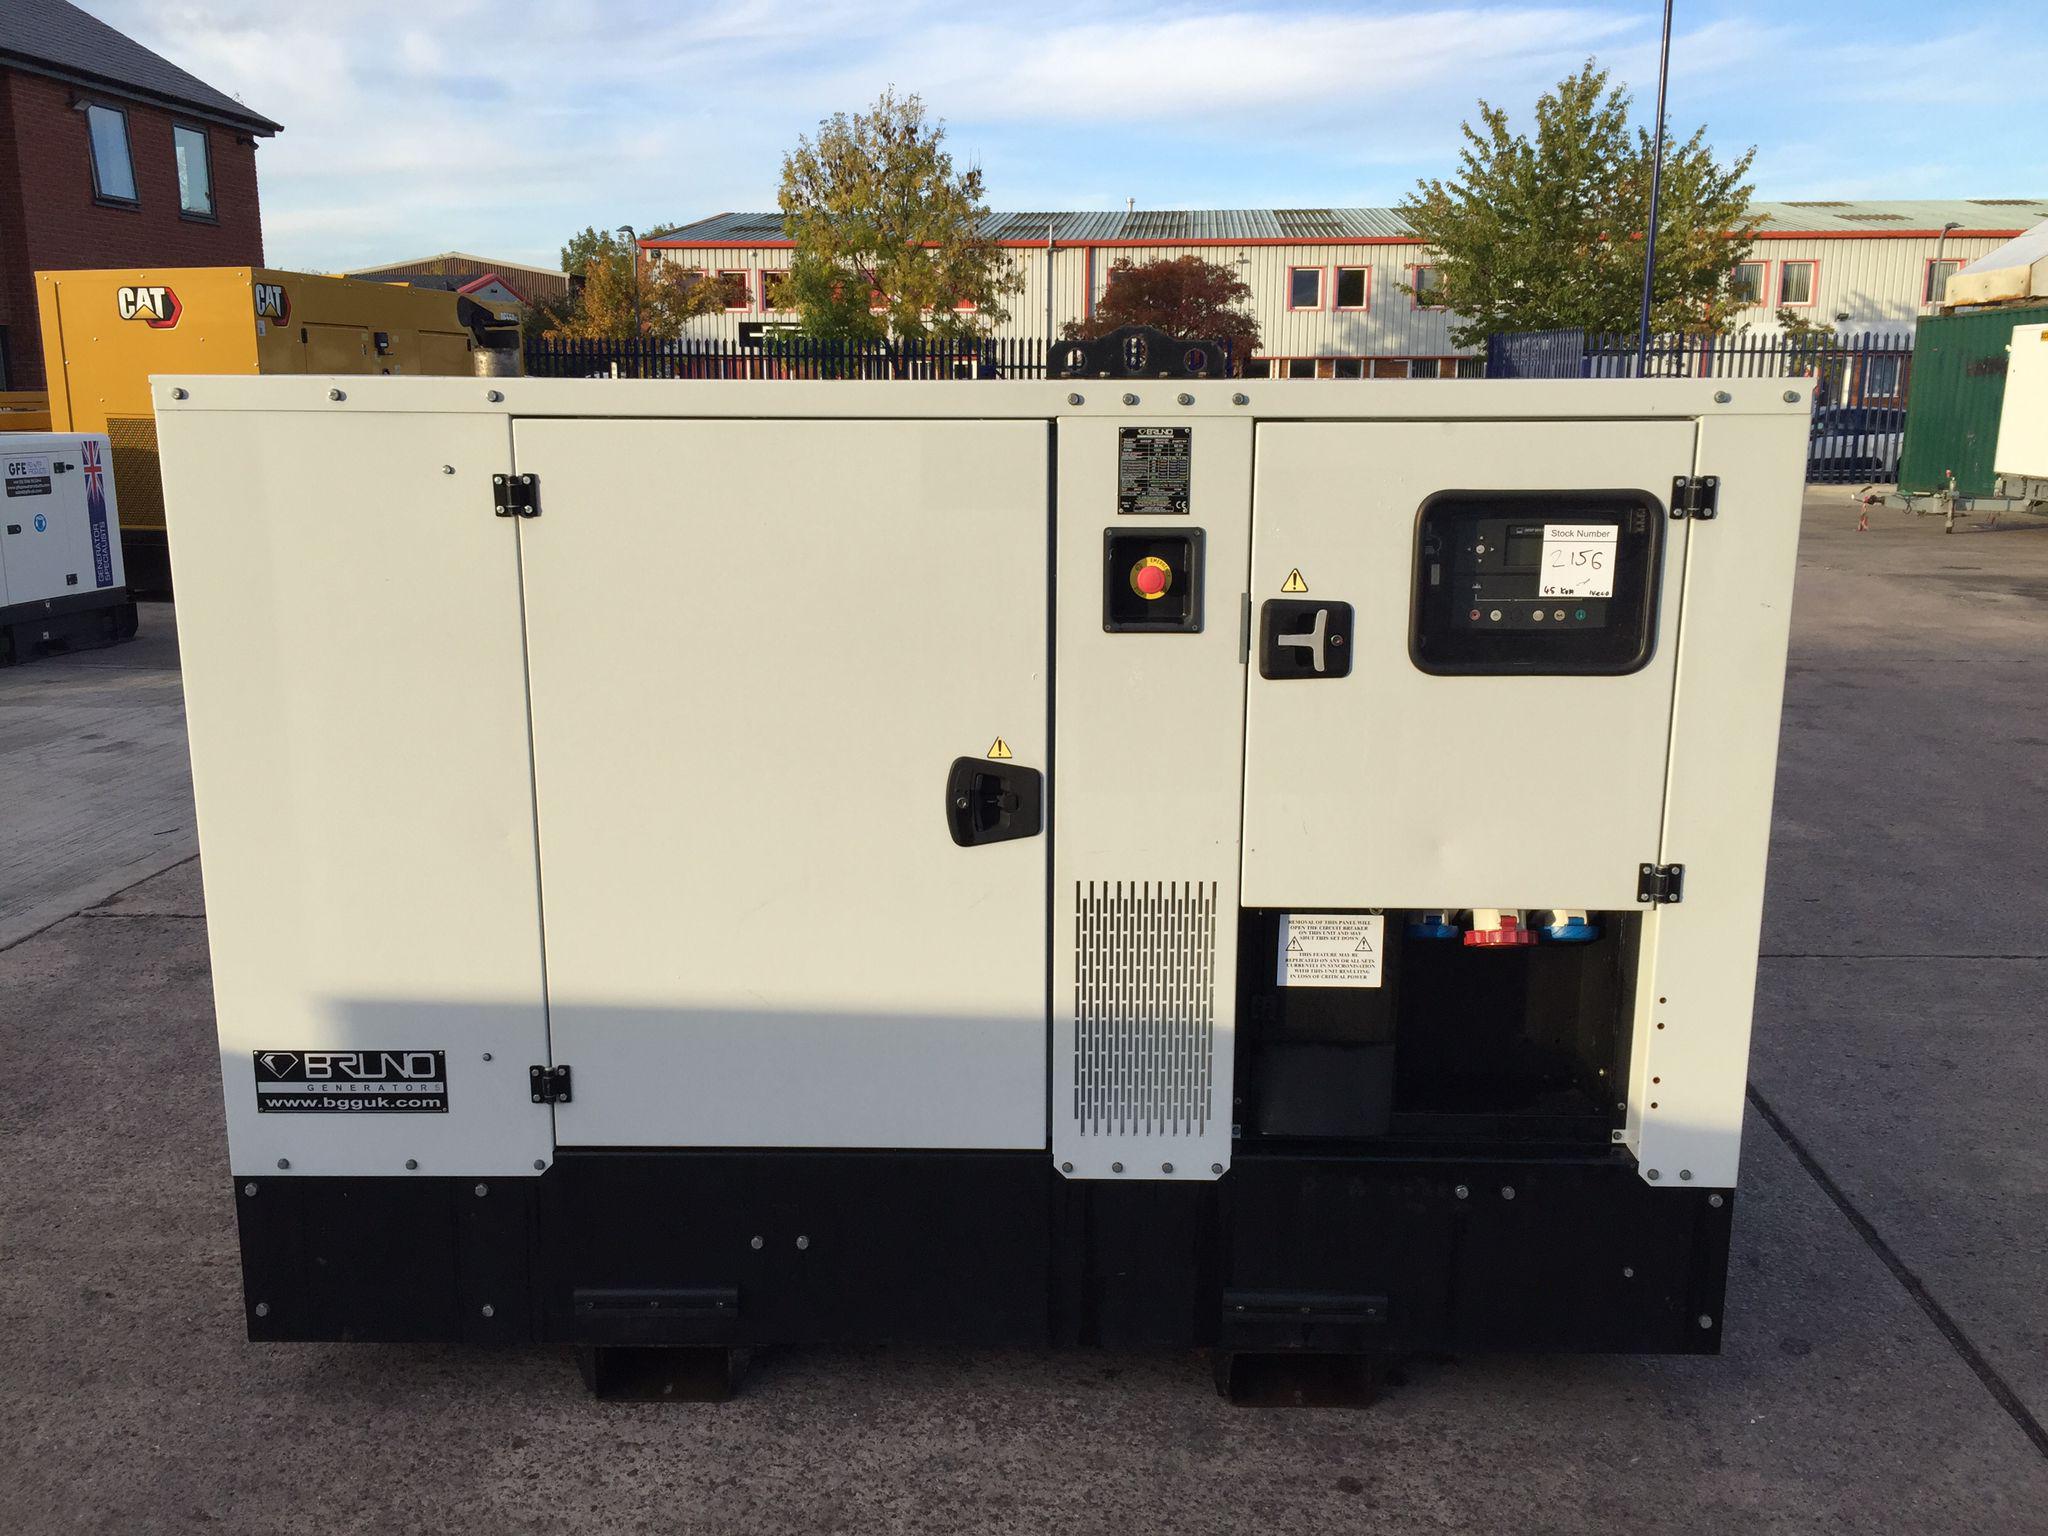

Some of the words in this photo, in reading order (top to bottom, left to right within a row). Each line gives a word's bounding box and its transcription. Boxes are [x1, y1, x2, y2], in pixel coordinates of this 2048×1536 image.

[118, 287, 165, 319] CAT
[256, 284, 282, 317] CAT
[9, 462, 26, 476] GFE
[1551, 530, 1574, 538] Stock
[1577, 530, 1610, 538] Number
[94, 523, 105, 583] GENERATOR
[99, 521, 111, 581] SPECIALISTS
[1551, 550, 1603, 570] 2156
[304, 1052, 436, 1079] BRUNO
[307, 1084, 442, 1092] GENERATORS
[266, 1097, 440, 1110] www.bgguk.com
